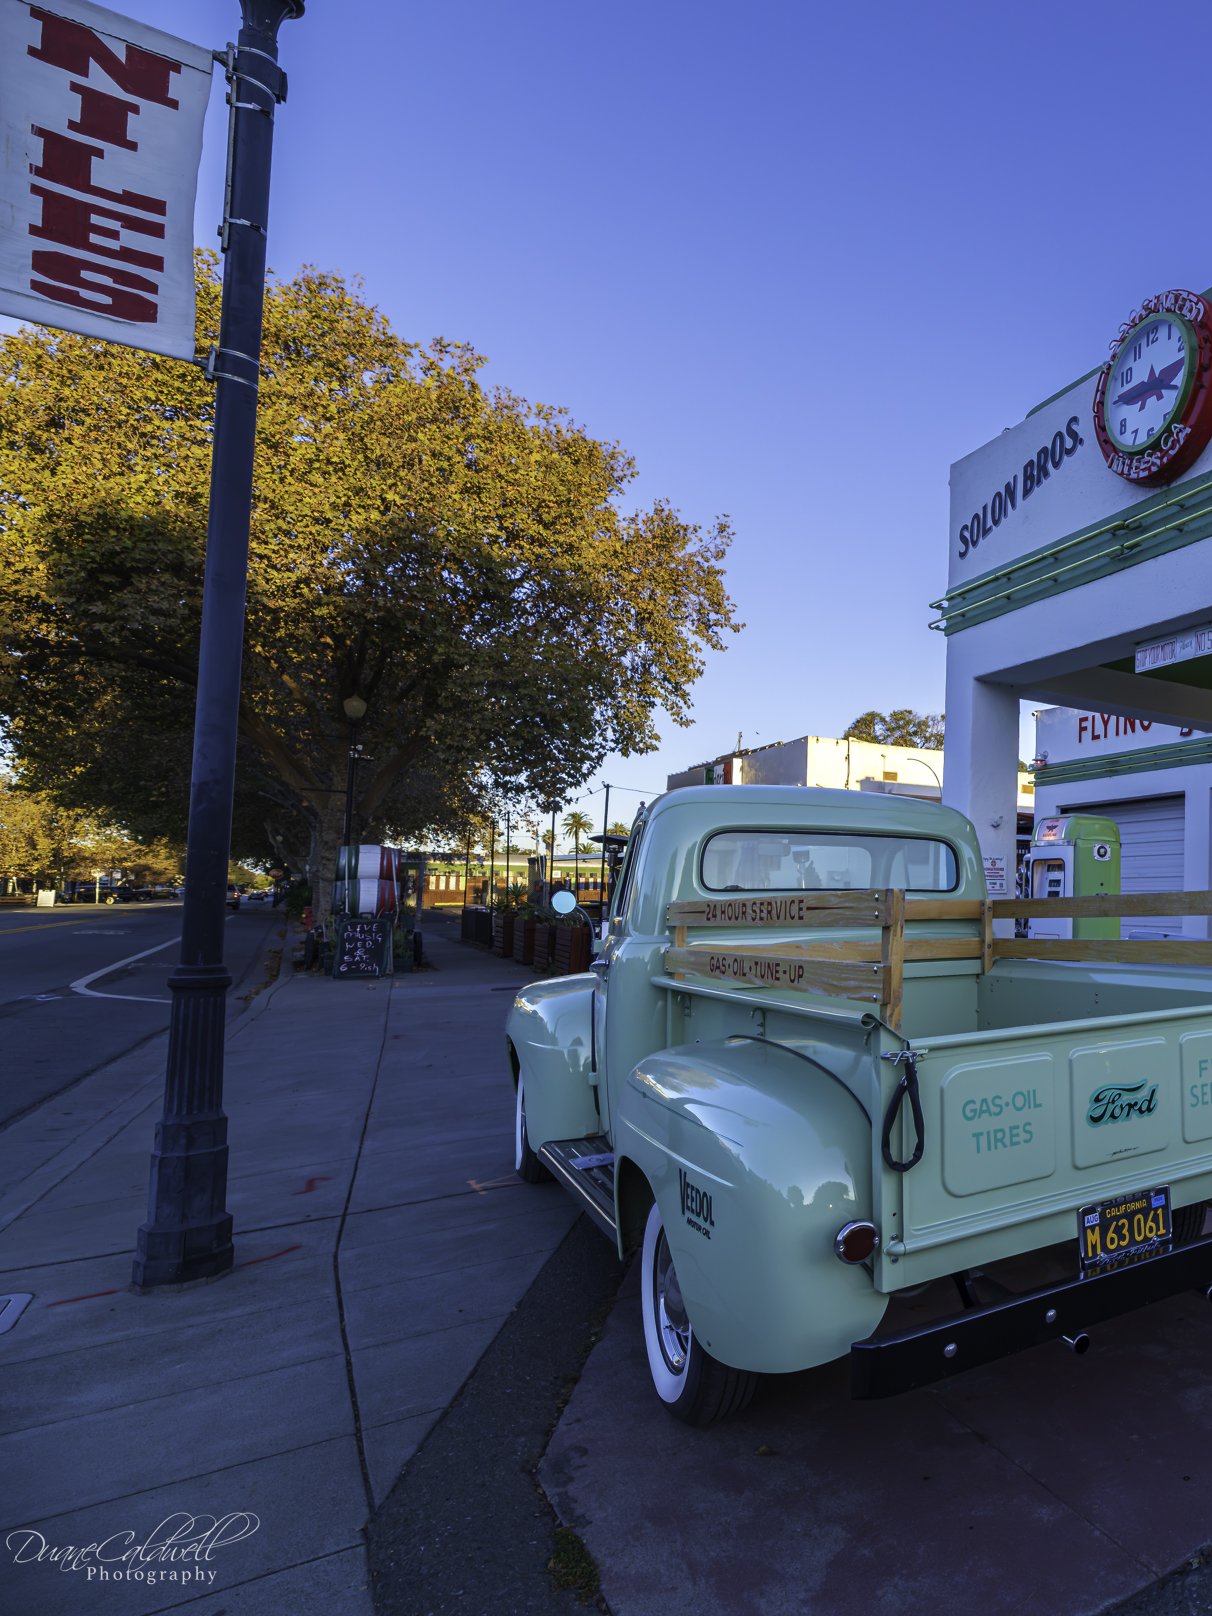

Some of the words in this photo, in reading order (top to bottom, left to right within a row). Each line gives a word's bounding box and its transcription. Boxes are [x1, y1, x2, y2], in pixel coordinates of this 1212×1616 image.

[27, 7, 182, 324] NILES
[1146, 325, 1159, 348] 12
[1167, 323, 1172, 340] 1
[1133, 343, 1142, 362] 11
[1120, 367, 1133, 388] 10
[1119, 417, 1127, 436] 8
[958, 475, 1019, 560] SOLON
[1022, 415, 1085, 501] BROS.
[1196, 632, 1206, 652] NO
[705, 903, 718, 921] 24
[720, 902, 748, 921] HOUR
[751, 899, 805, 922] SERVICE
[347, 923, 379, 932] LIVE
[1087, 1080, 1158, 1126] Ford
[971, 1122, 1035, 1155] TIRES
[678, 1168, 715, 1228] VEEDOL
[1105, 1199, 1147, 1219] CALIFORNIA
[1086, 1213, 1099, 1225] AUG
[1086, 1226, 1101, 1257] M
[1106, 1218, 1130, 1250] 63
[1133, 1207, 1167, 1242] 061
